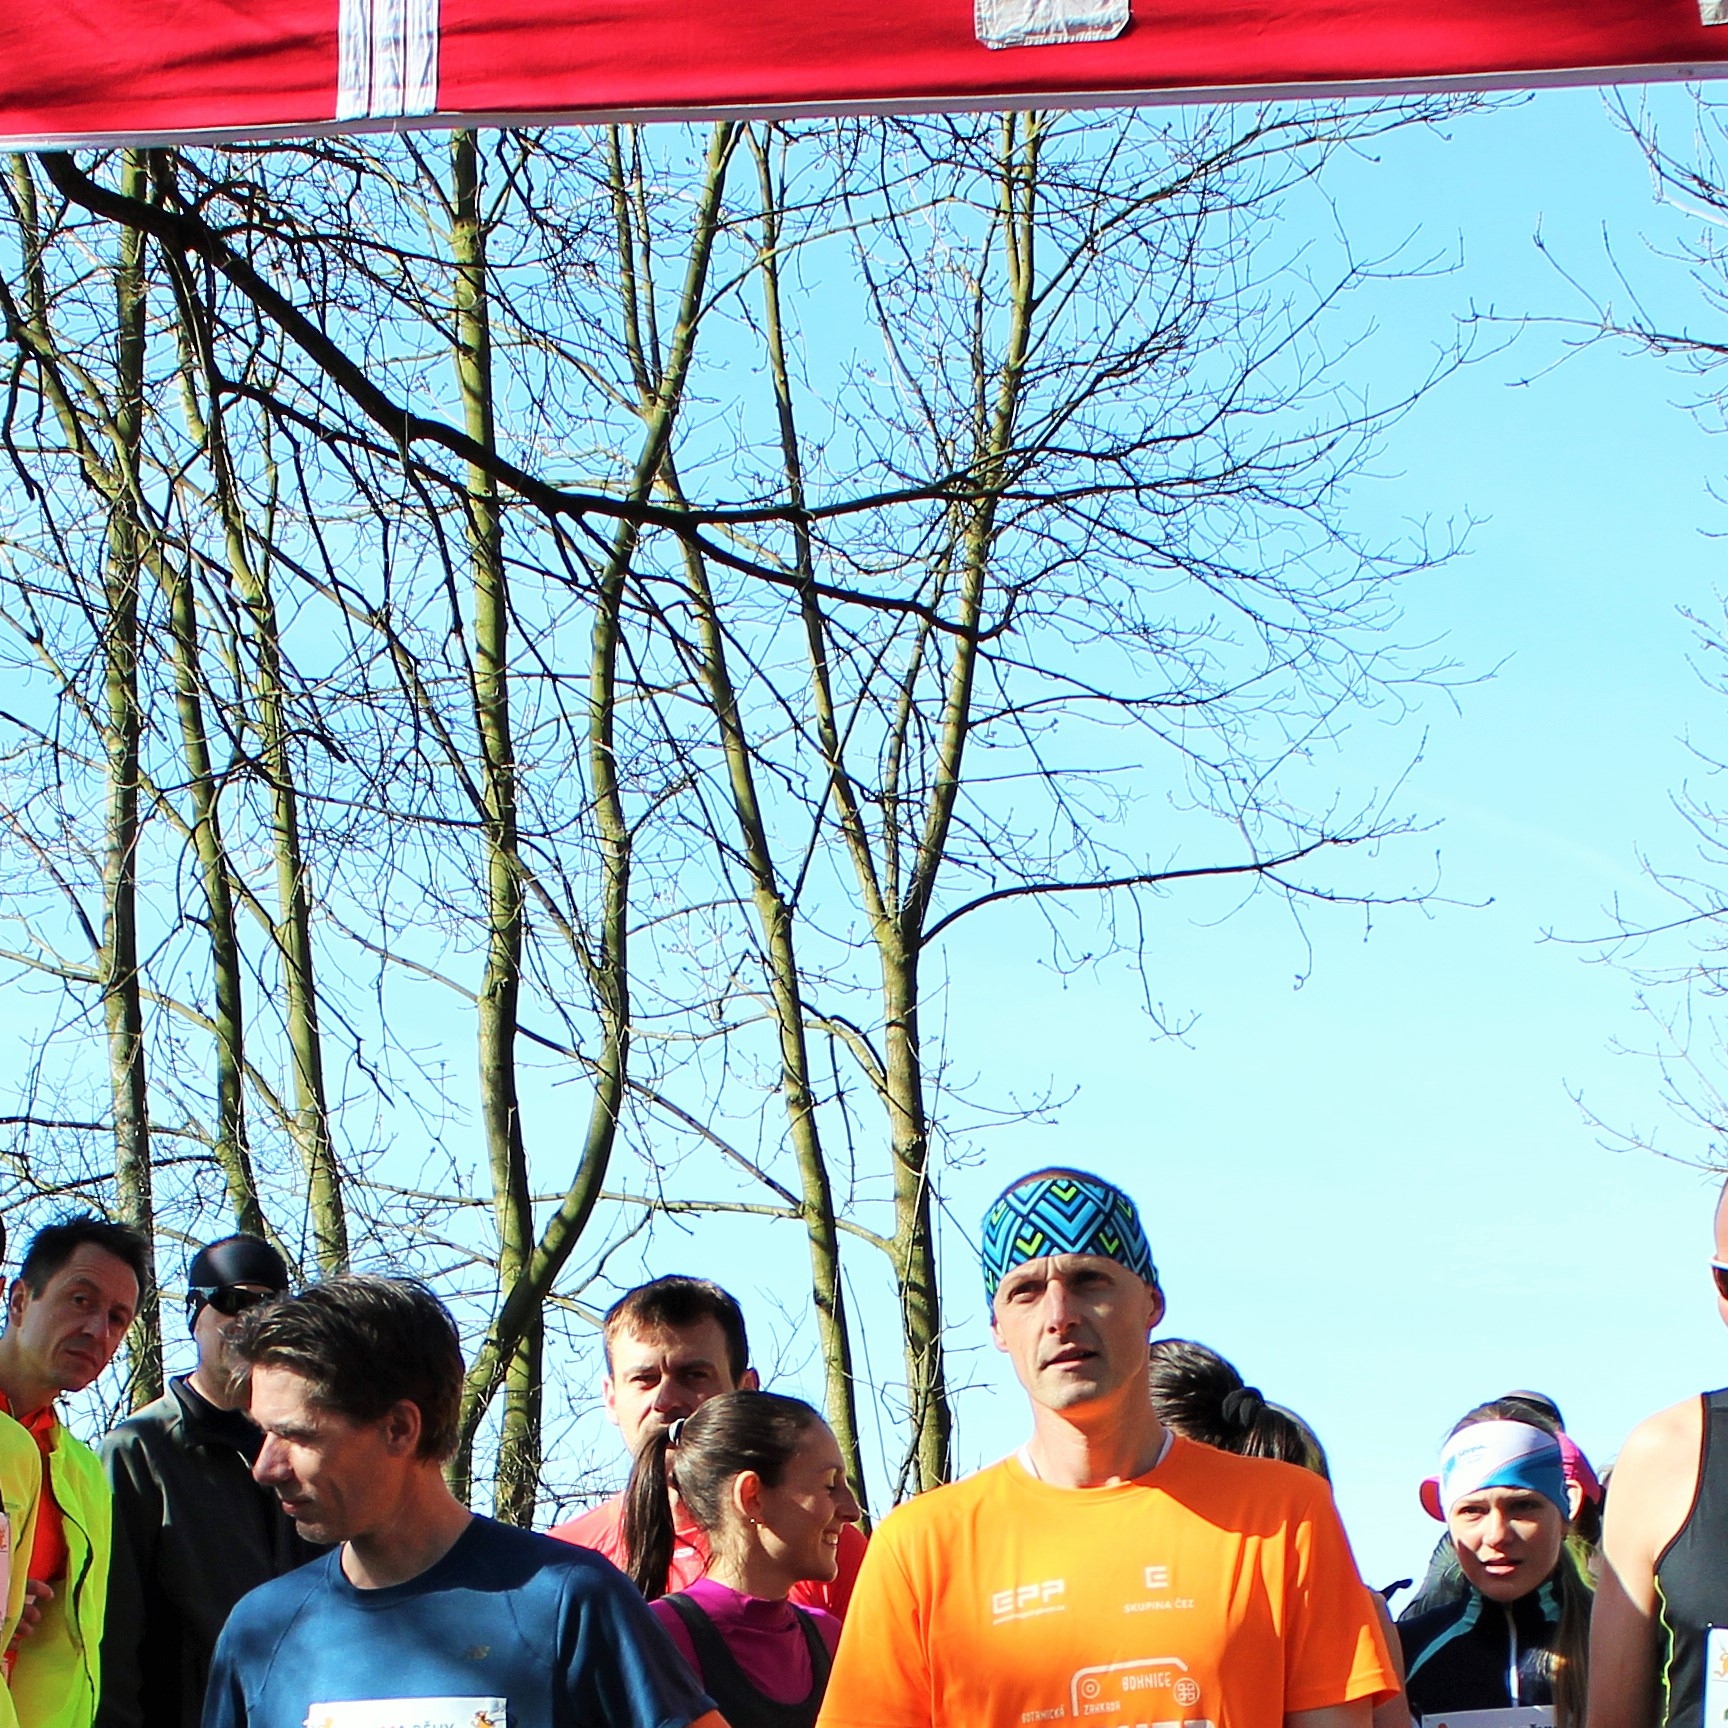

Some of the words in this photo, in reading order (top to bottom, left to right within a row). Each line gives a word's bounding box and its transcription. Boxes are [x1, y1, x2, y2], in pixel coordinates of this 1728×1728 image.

[992, 1578, 1065, 1614] EPP
[1124, 1601, 1172, 1613] SKUPINA
[1174, 1597, 1195, 1609] ČEZ
[1122, 1671, 1171, 1691] BOHNICE
